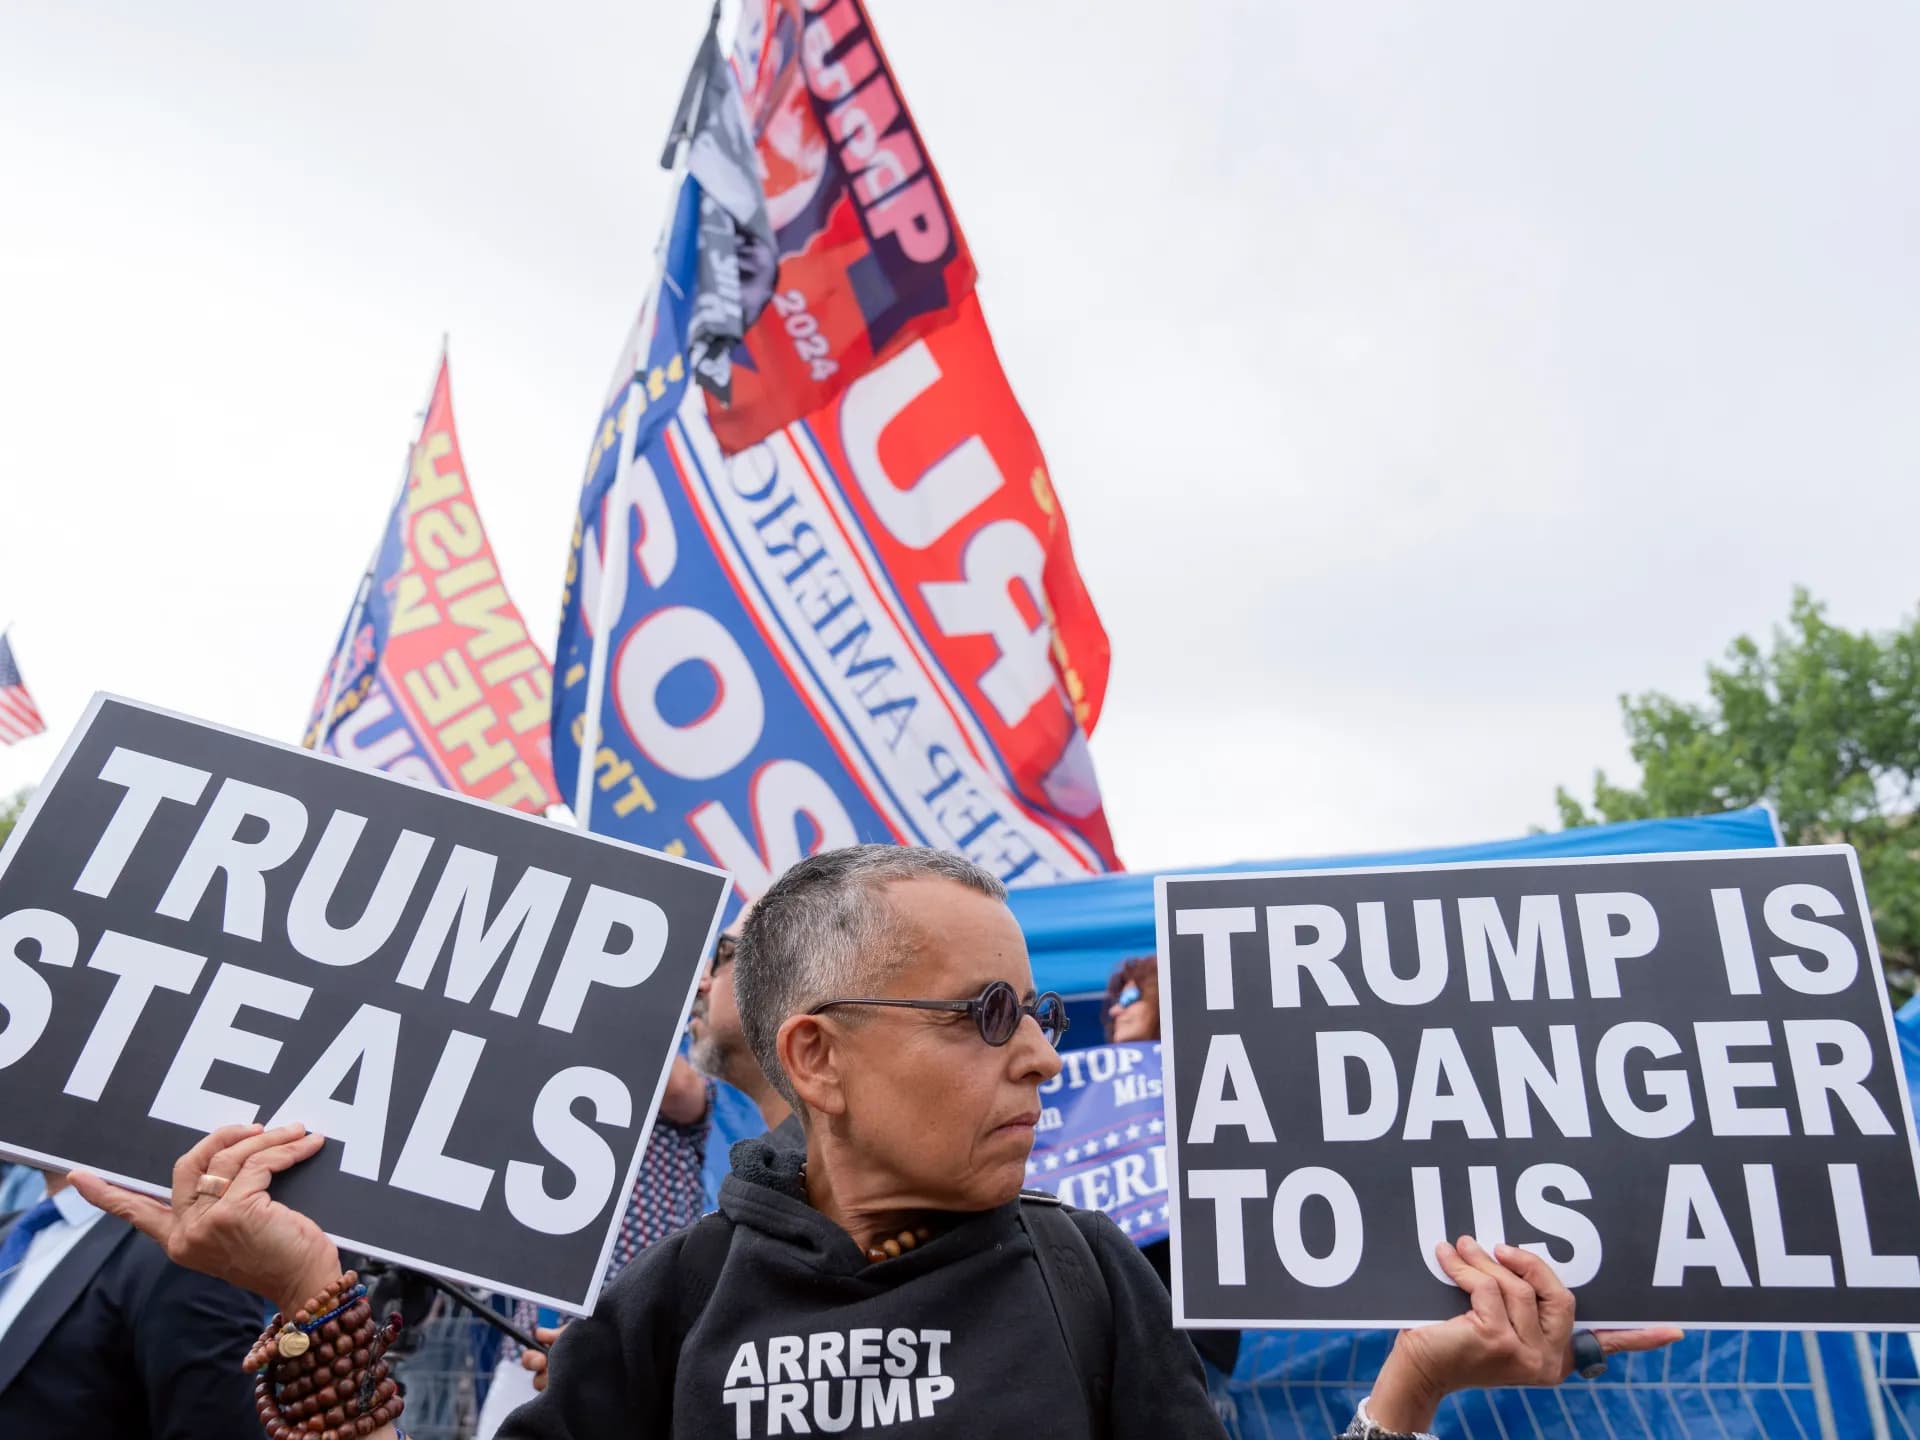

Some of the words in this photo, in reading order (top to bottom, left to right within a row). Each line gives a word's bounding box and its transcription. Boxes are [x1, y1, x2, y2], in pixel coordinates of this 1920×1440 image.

[799, 0, 951, 264] UMP
[773, 289, 840, 382] 2024
[72, 747, 670, 1034] TRUMP
[1175, 891, 1660, 1011] TRUMP
[1710, 883, 1860, 996] IS
[0, 908, 633, 1236] STEALS
[1113, 1073, 1163, 1108] Mis
[1187, 1033, 1278, 1144] A
[1315, 1019, 1897, 1143] DANGER
[1186, 1165, 1365, 1288] TO
[1410, 1162, 1604, 1288] US
[1651, 1163, 1920, 1288] ALL
[722, 1375, 956, 1440] TRUMP
[723, 1327, 952, 1389] ARREST
